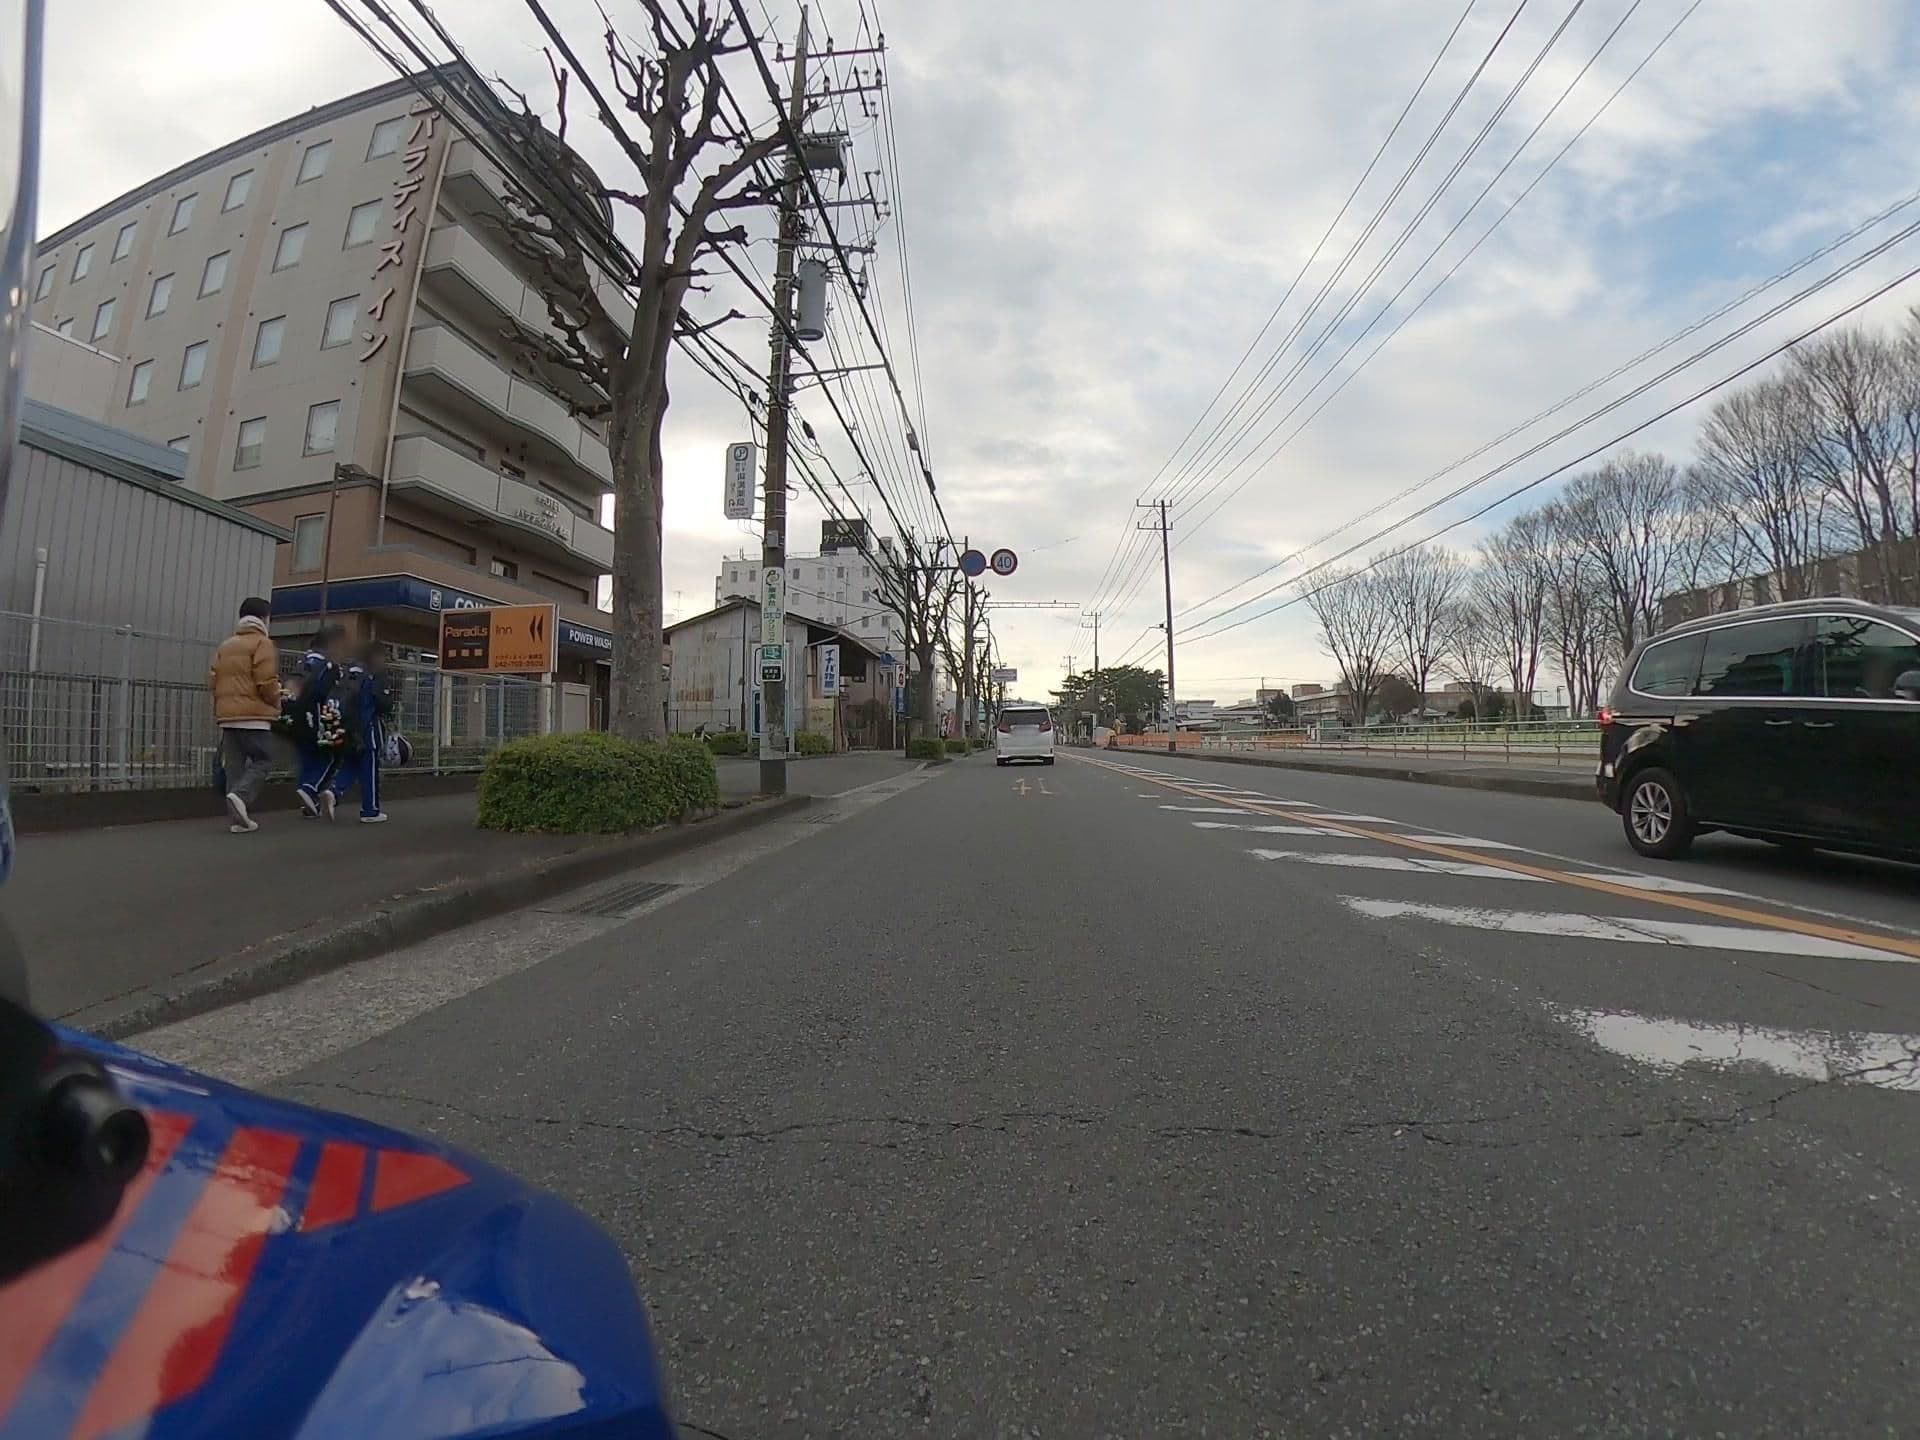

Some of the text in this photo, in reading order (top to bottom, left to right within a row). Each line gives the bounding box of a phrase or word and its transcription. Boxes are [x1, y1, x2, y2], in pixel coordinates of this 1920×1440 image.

[997, 556, 1011, 568] 40
[569, 630, 612, 649] POWER WASH
